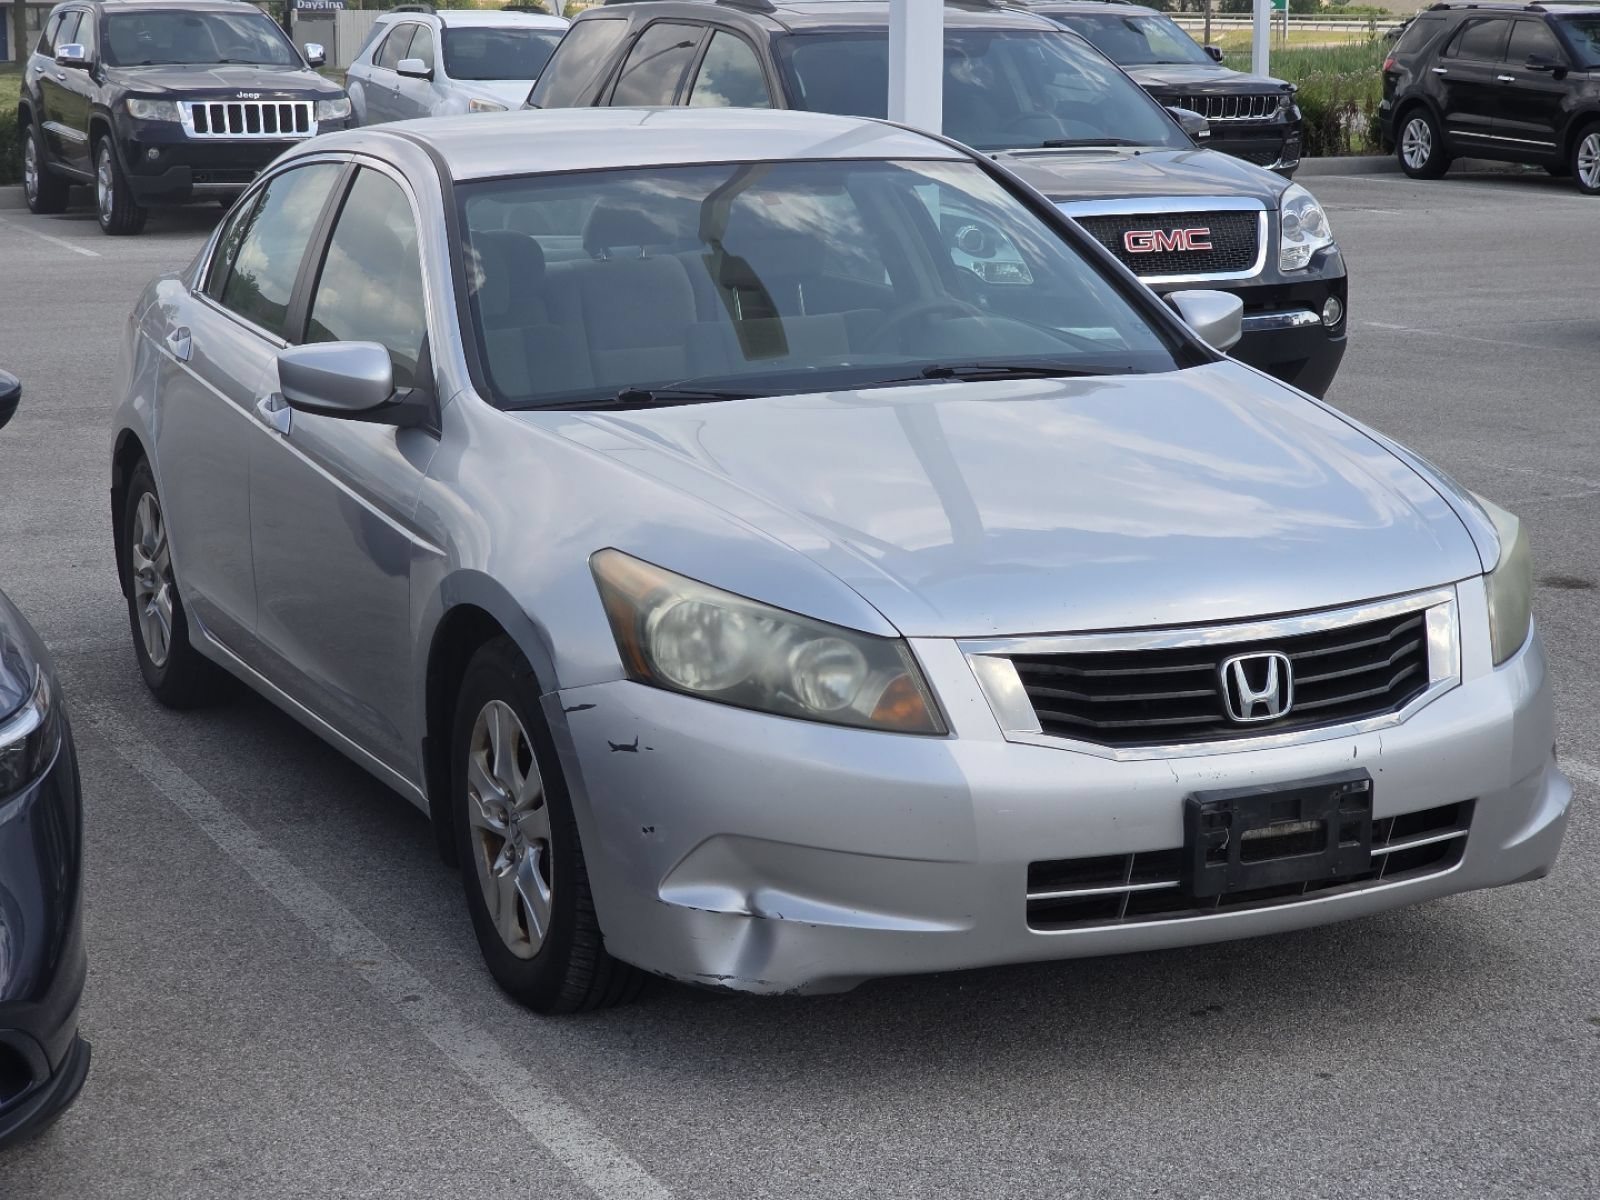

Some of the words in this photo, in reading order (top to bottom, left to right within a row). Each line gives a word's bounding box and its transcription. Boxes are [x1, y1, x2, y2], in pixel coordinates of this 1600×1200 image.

[297, 0, 324, 9] Days
[236, 91, 260, 99] Jeep
[1124, 228, 1212, 252] GMC
